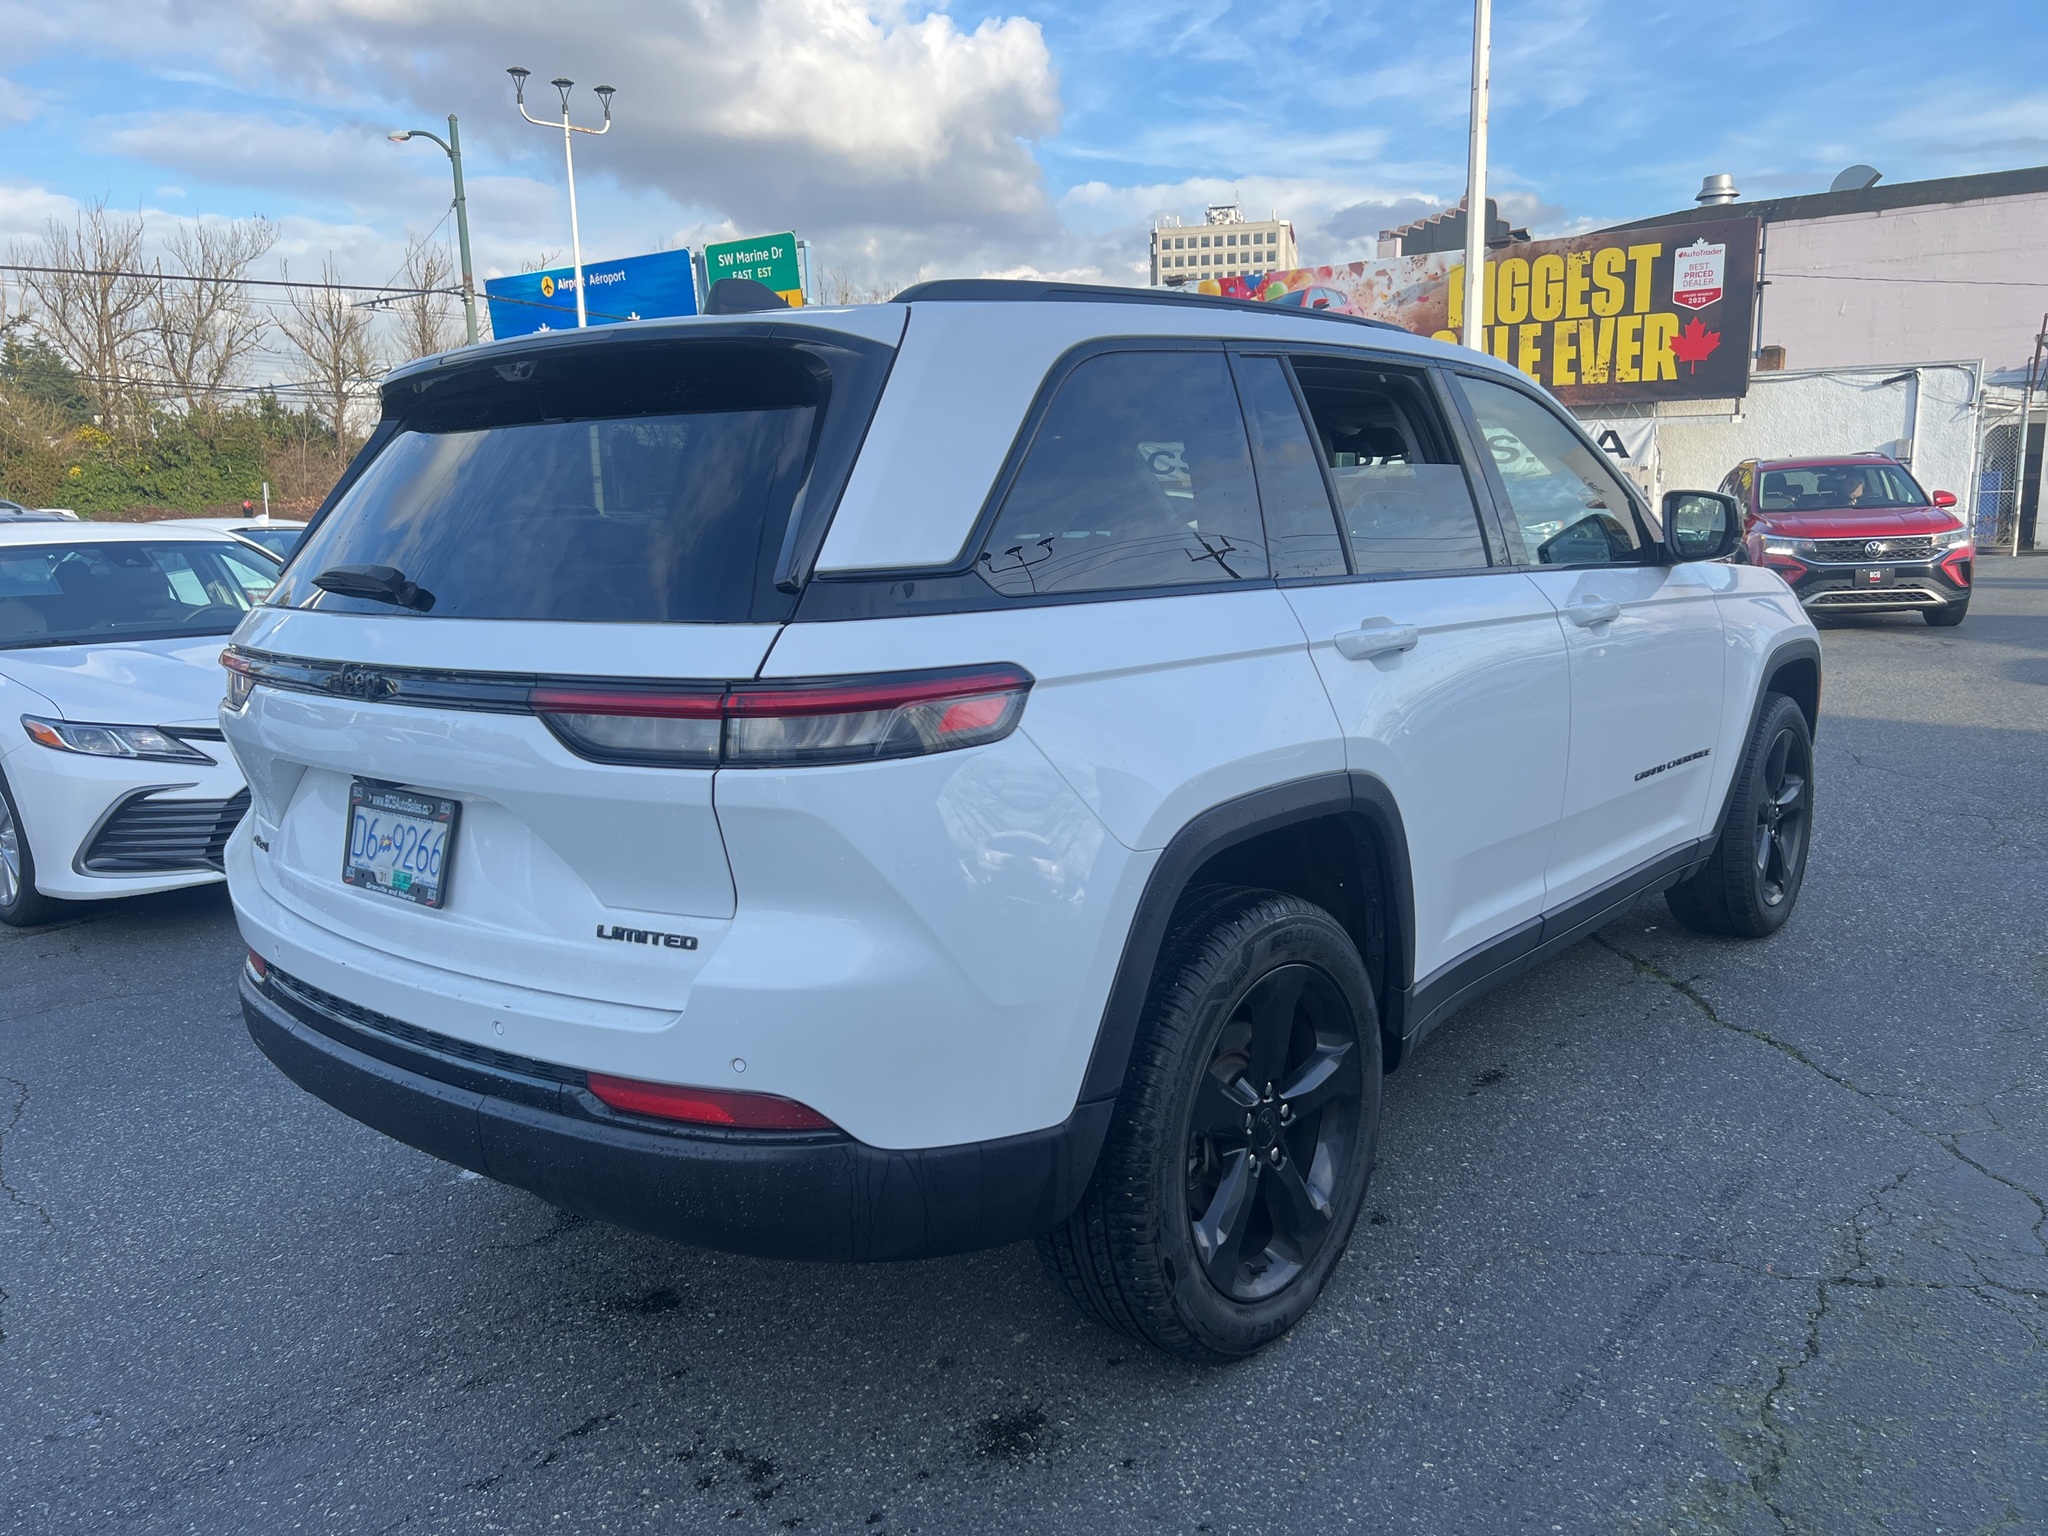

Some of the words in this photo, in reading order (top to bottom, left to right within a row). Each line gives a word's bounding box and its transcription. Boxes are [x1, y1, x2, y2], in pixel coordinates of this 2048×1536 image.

[718, 253, 734, 267] SW
[736, 249, 769, 264] Marine
[771, 246, 783, 259] Dr
[1682, 249, 1722, 258] AutoTrader
[757, 266, 772, 278] EST
[1689, 262, 1710, 271] BEST
[589, 270, 626, 287] Aéroport
[1684, 270, 1714, 279] PRICED
[1682, 278, 1714, 287] DEALER
[1688, 296, 1706, 304] 2025
[1552, 312, 1679, 386] EVER
[1634, 763, 1666, 782] GRAND
[1667, 747, 1712, 770] CHEROKEE
[353, 786, 364, 798] BCS
[440, 801, 452, 815] BCS
[346, 866, 356, 878] BCS
[379, 871, 387, 883] 31
[398, 890, 416, 902] Marine
[427, 888, 437, 900] BCS
[596, 924, 699, 951] LIMITED
